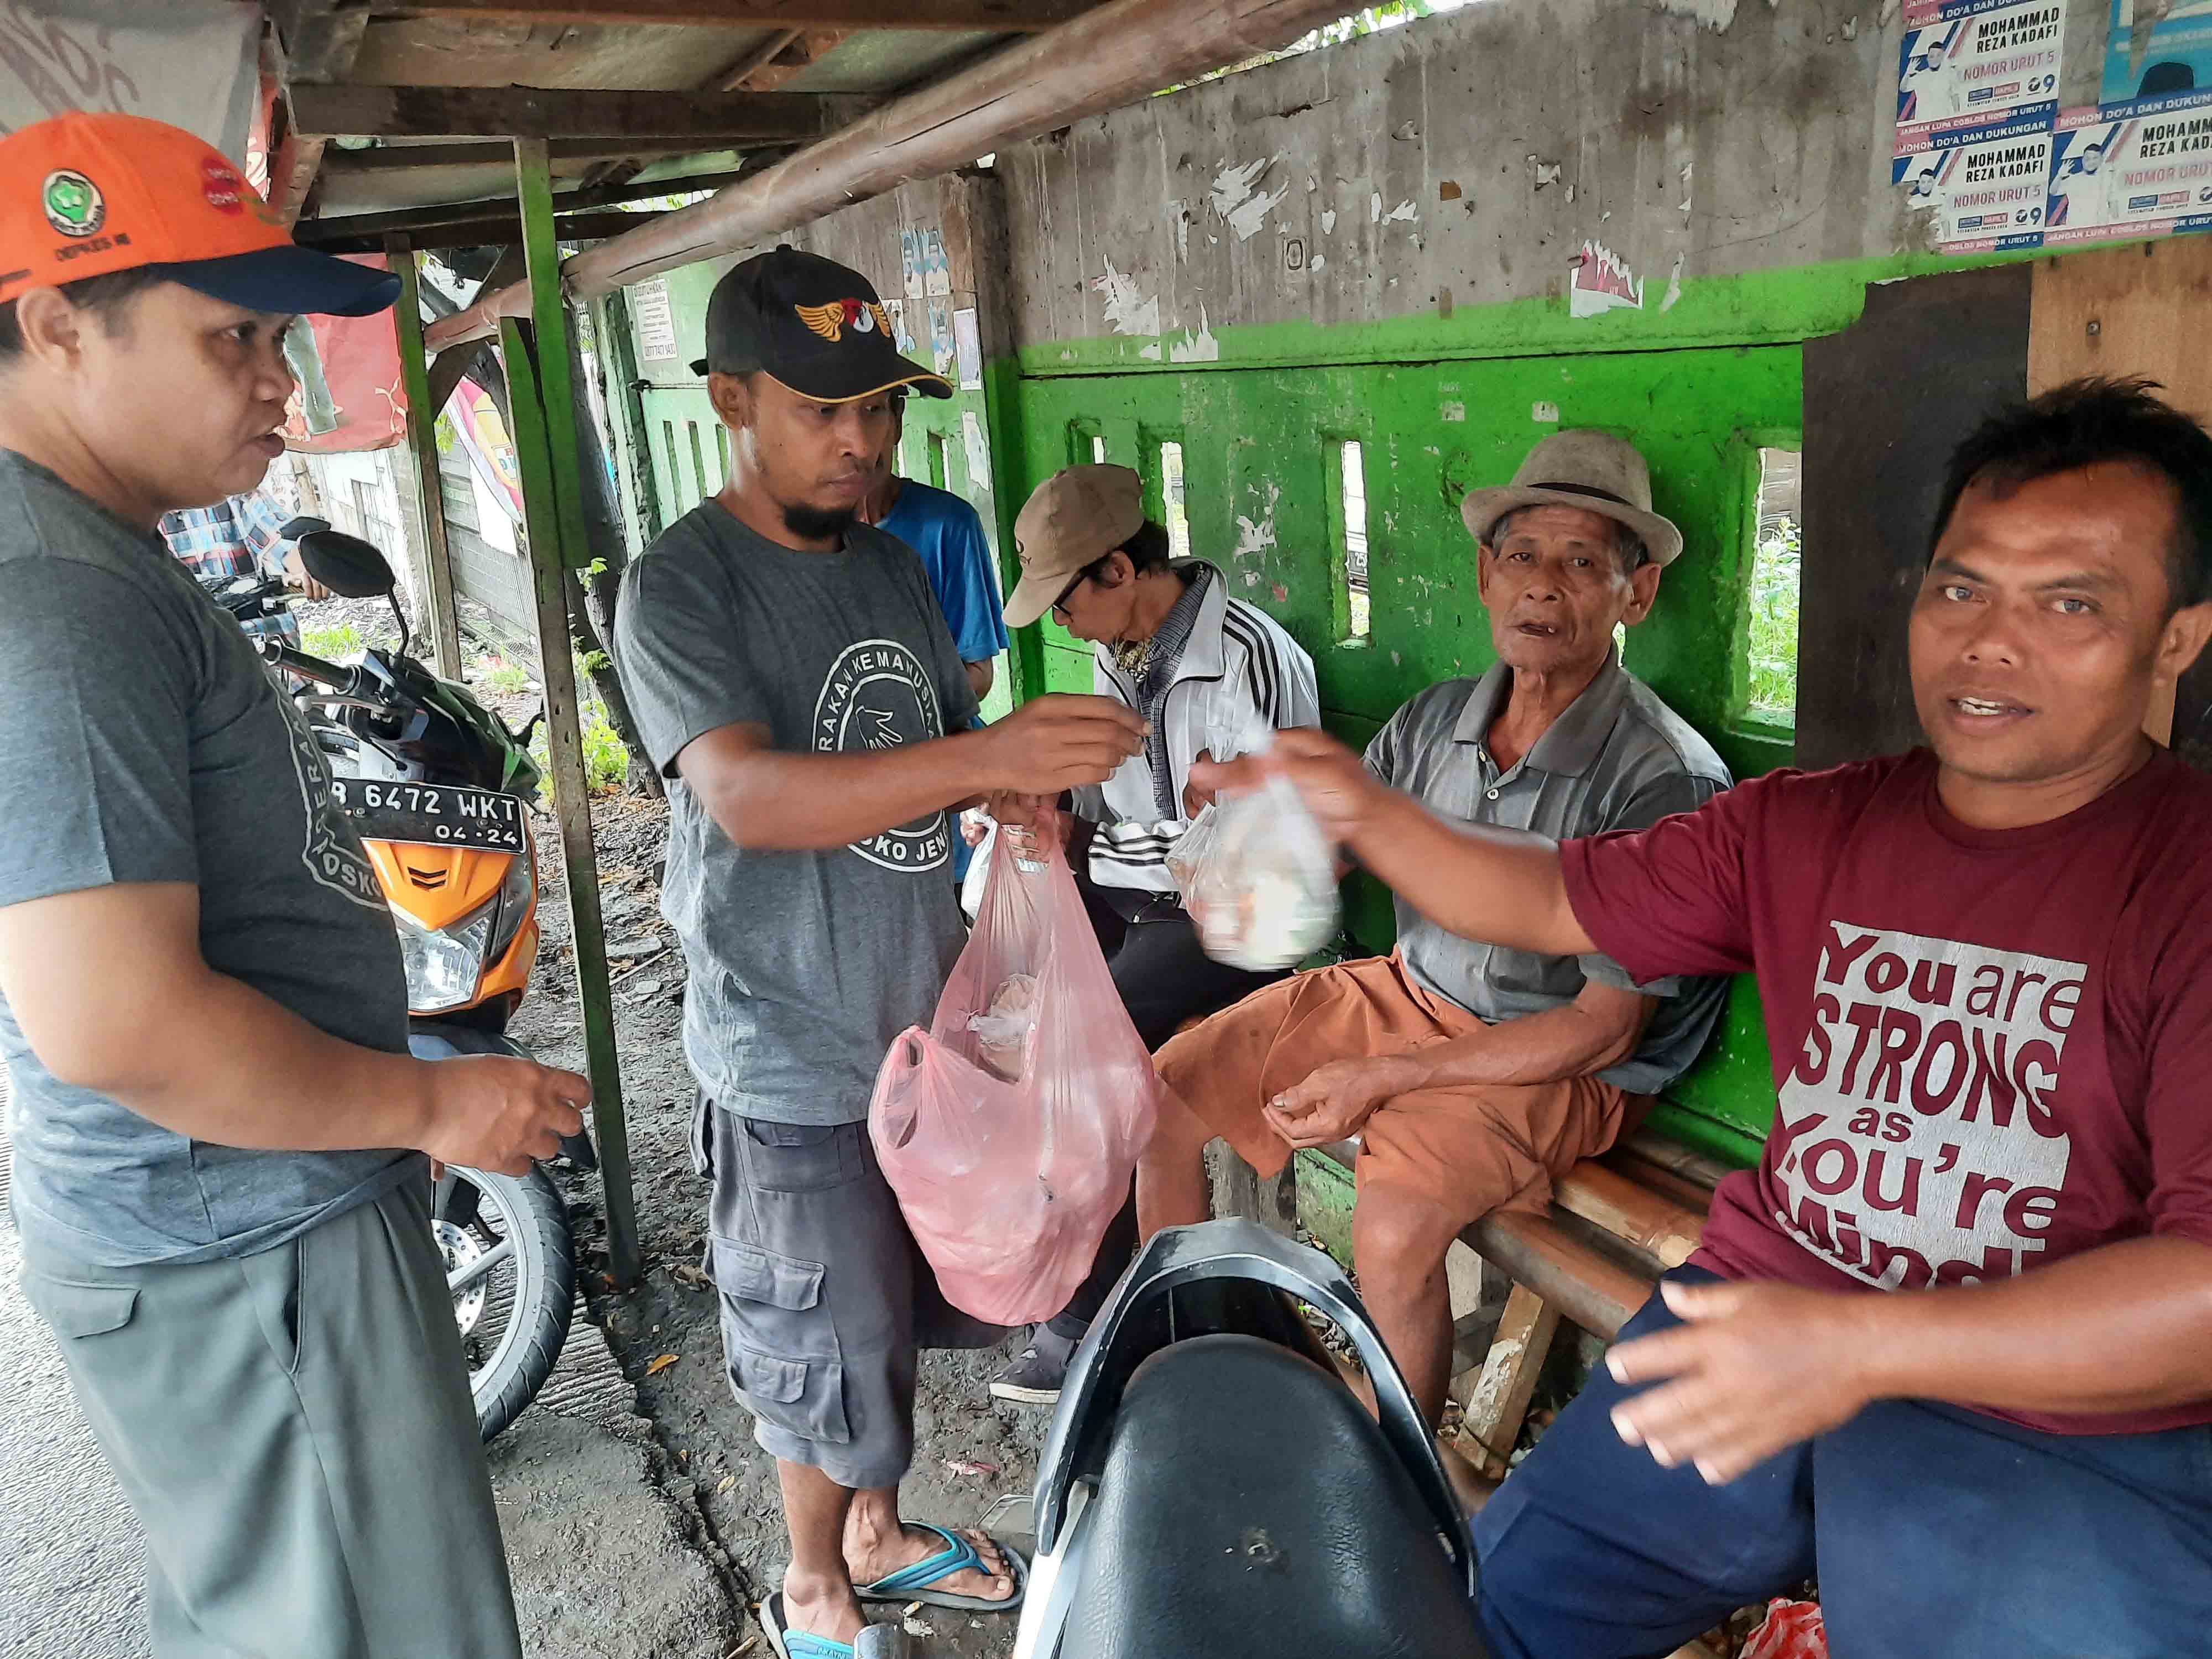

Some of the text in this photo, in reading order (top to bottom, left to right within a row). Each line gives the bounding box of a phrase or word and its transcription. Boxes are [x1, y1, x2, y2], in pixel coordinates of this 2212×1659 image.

[1978, 7, 2059, 39] MOHAMMAD
[1976, 25, 2058, 54] REZA KADAFI
[1964, 60, 2007, 81] NOMOR
[2043, 74, 2056, 93] 9
[2060, 113, 2102, 127] MOHON
[2137, 101, 2163, 114] DAN
[2166, 93, 2212, 108] DUKUN
[1900, 121, 2046, 153] MOHON DO'A DAN DUKUNGAN
[2140, 135, 2212, 159] REZA KAD
[1966, 160, 2043, 183] REZA KADAFI
[1968, 144, 2045, 168] MOHAMMAD
[1954, 191, 1995, 208] NOMOR
[1999, 186, 2032, 203] URUT
[2030, 207, 2042, 225] 9
[818, 668, 854, 751] RAKAN
[365, 784, 441, 814] 6472
[457, 793, 515, 821] WKT
[1823, 933, 2084, 1034] You are
[1796, 992, 2069, 1139] STRONG
[1848, 1107, 1914, 1143] as
[1786, 1113, 2063, 1240] You're
